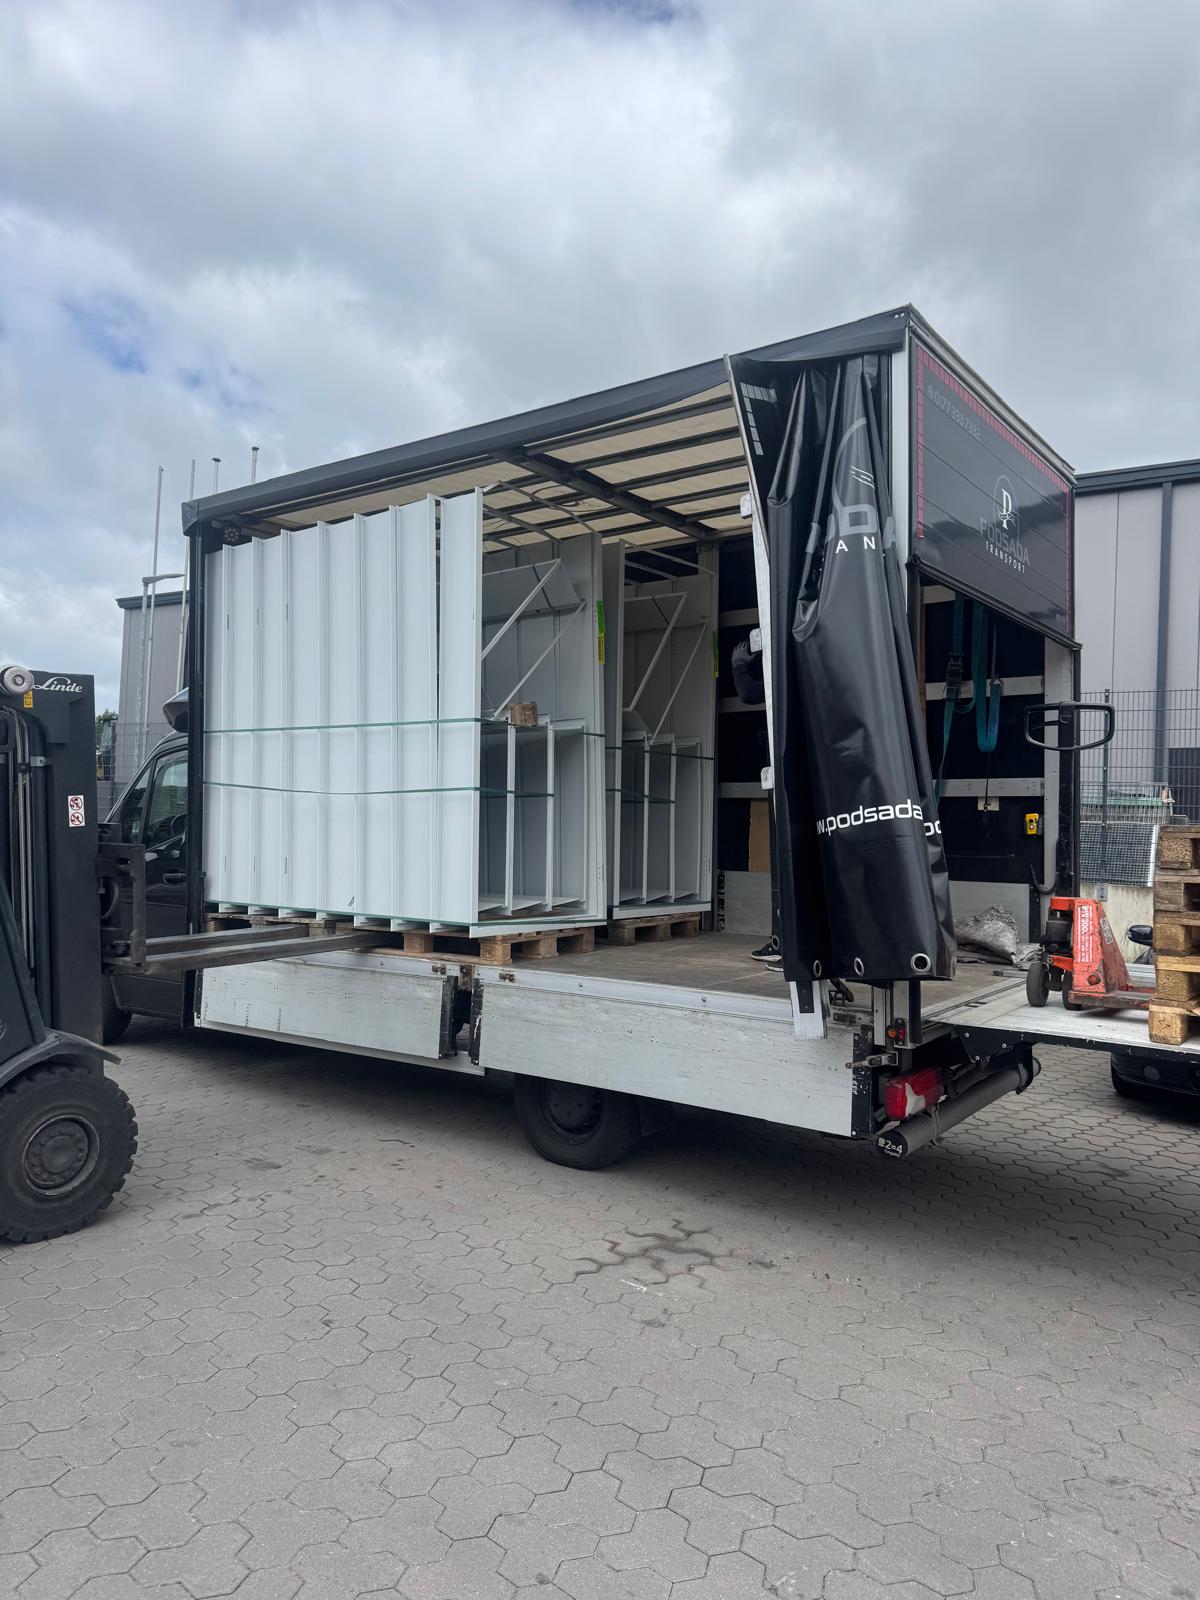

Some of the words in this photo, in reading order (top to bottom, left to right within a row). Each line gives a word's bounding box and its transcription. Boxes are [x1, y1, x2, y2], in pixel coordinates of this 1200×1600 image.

[980, 515, 1031, 567] PODSADA
[985, 541, 1025, 574] TRANSPORT
[33, 676, 83, 693] Linde
